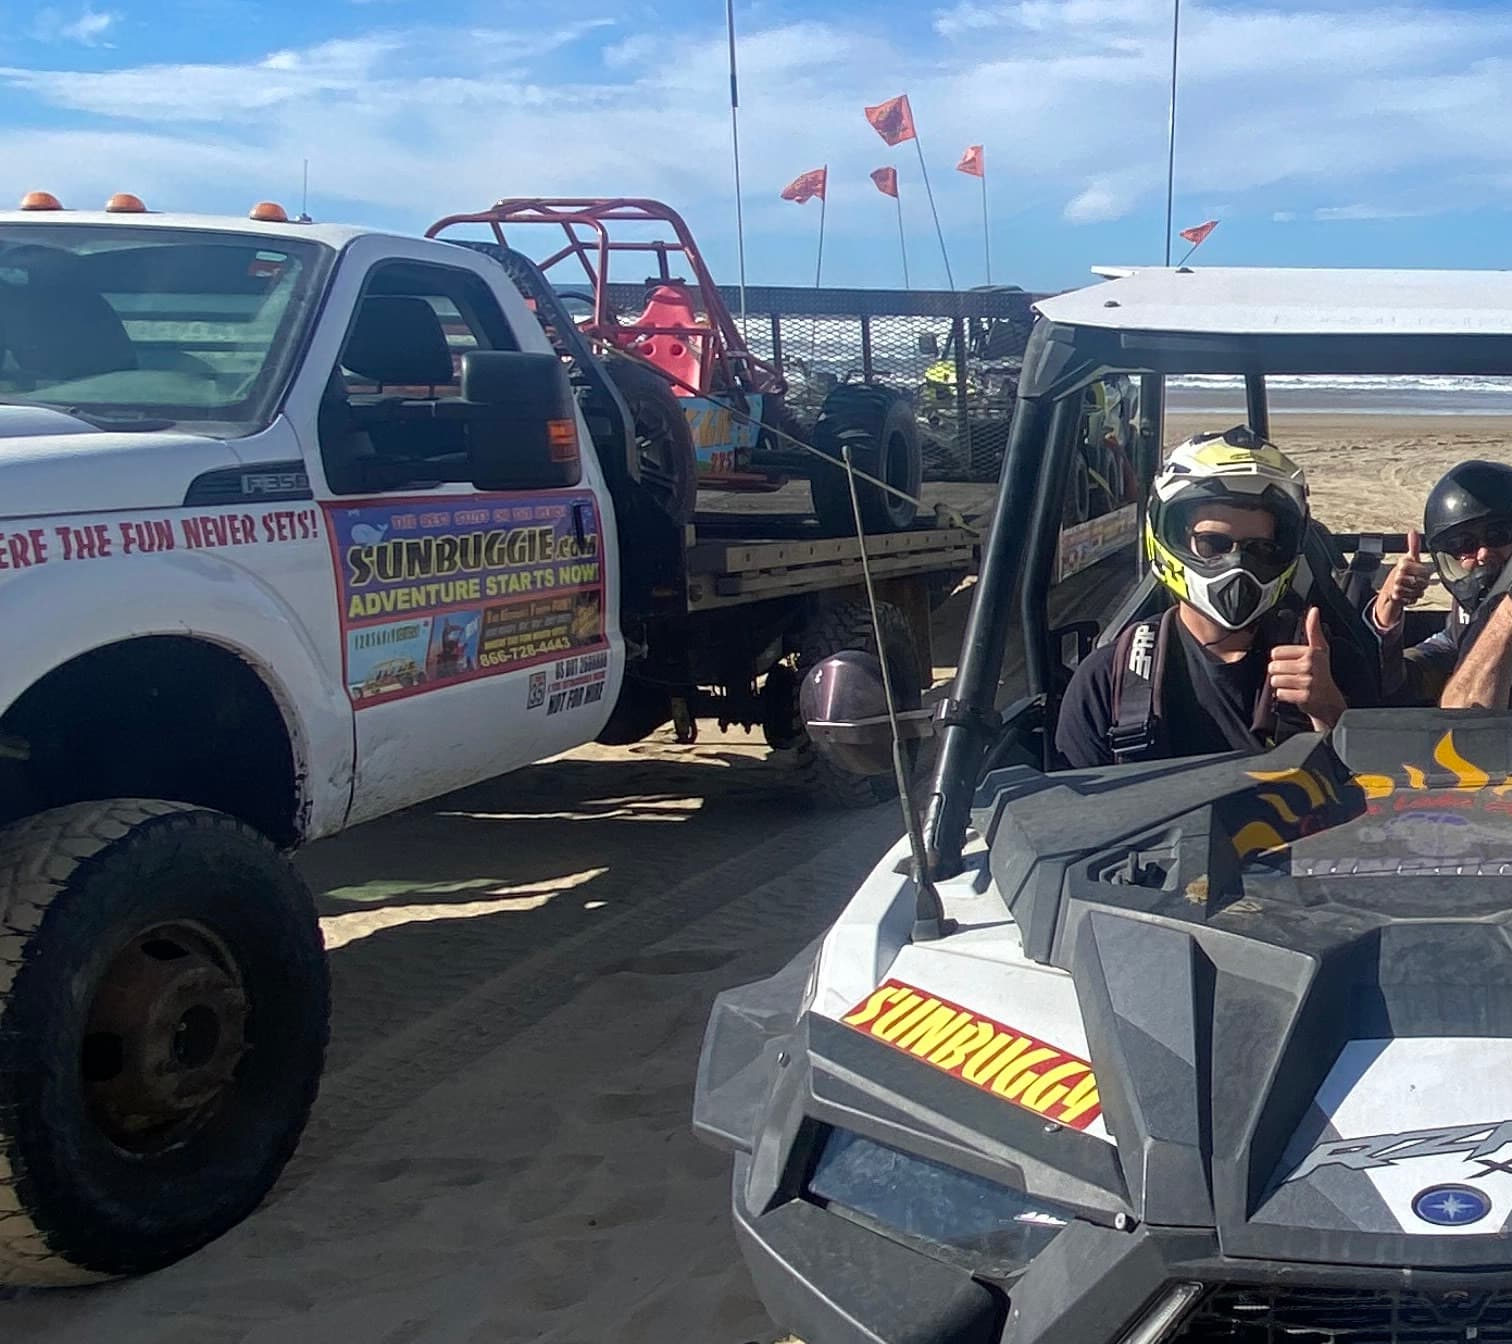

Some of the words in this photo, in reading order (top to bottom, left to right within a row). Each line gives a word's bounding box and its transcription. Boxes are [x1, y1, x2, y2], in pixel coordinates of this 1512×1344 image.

[56, 525, 112, 560] THE
[119, 520, 175, 554] FUN
[181, 513, 258, 549] NEVER
[262, 509, 317, 543] SETS!
[349, 579, 481, 618] ADVENTURE
[486, 569, 555, 597] STARTS
[480, 637, 571, 667] 866-728-4443
[843, 986, 1100, 1123] SUNBUGGY
